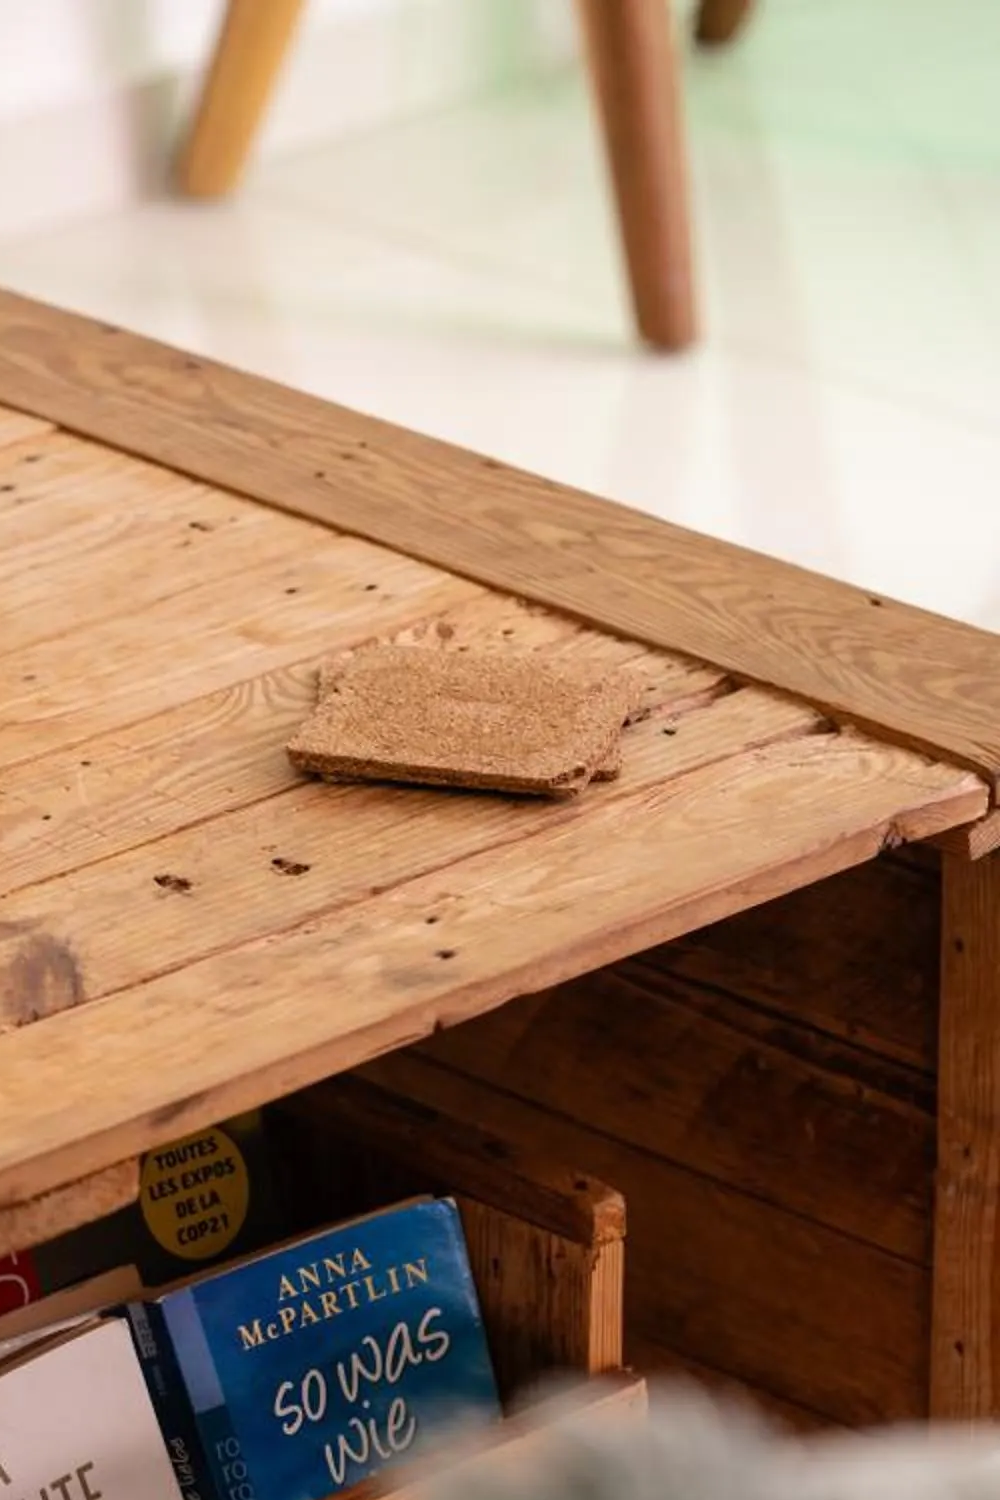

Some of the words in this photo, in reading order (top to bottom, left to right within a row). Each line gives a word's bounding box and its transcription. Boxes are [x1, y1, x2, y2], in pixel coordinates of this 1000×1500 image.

[155, 1137, 218, 1170] TOUTES
[148, 1177, 178, 1201] LES
[181, 1157, 236, 1190] EXPOS
[175, 1196, 197, 1219] DE
[199, 1190, 221, 1211] LA
[176, 1214, 230, 1246] COP21
[278, 1247, 373, 1301] ANNA
[237, 1257, 431, 1351] McPARTLIN
